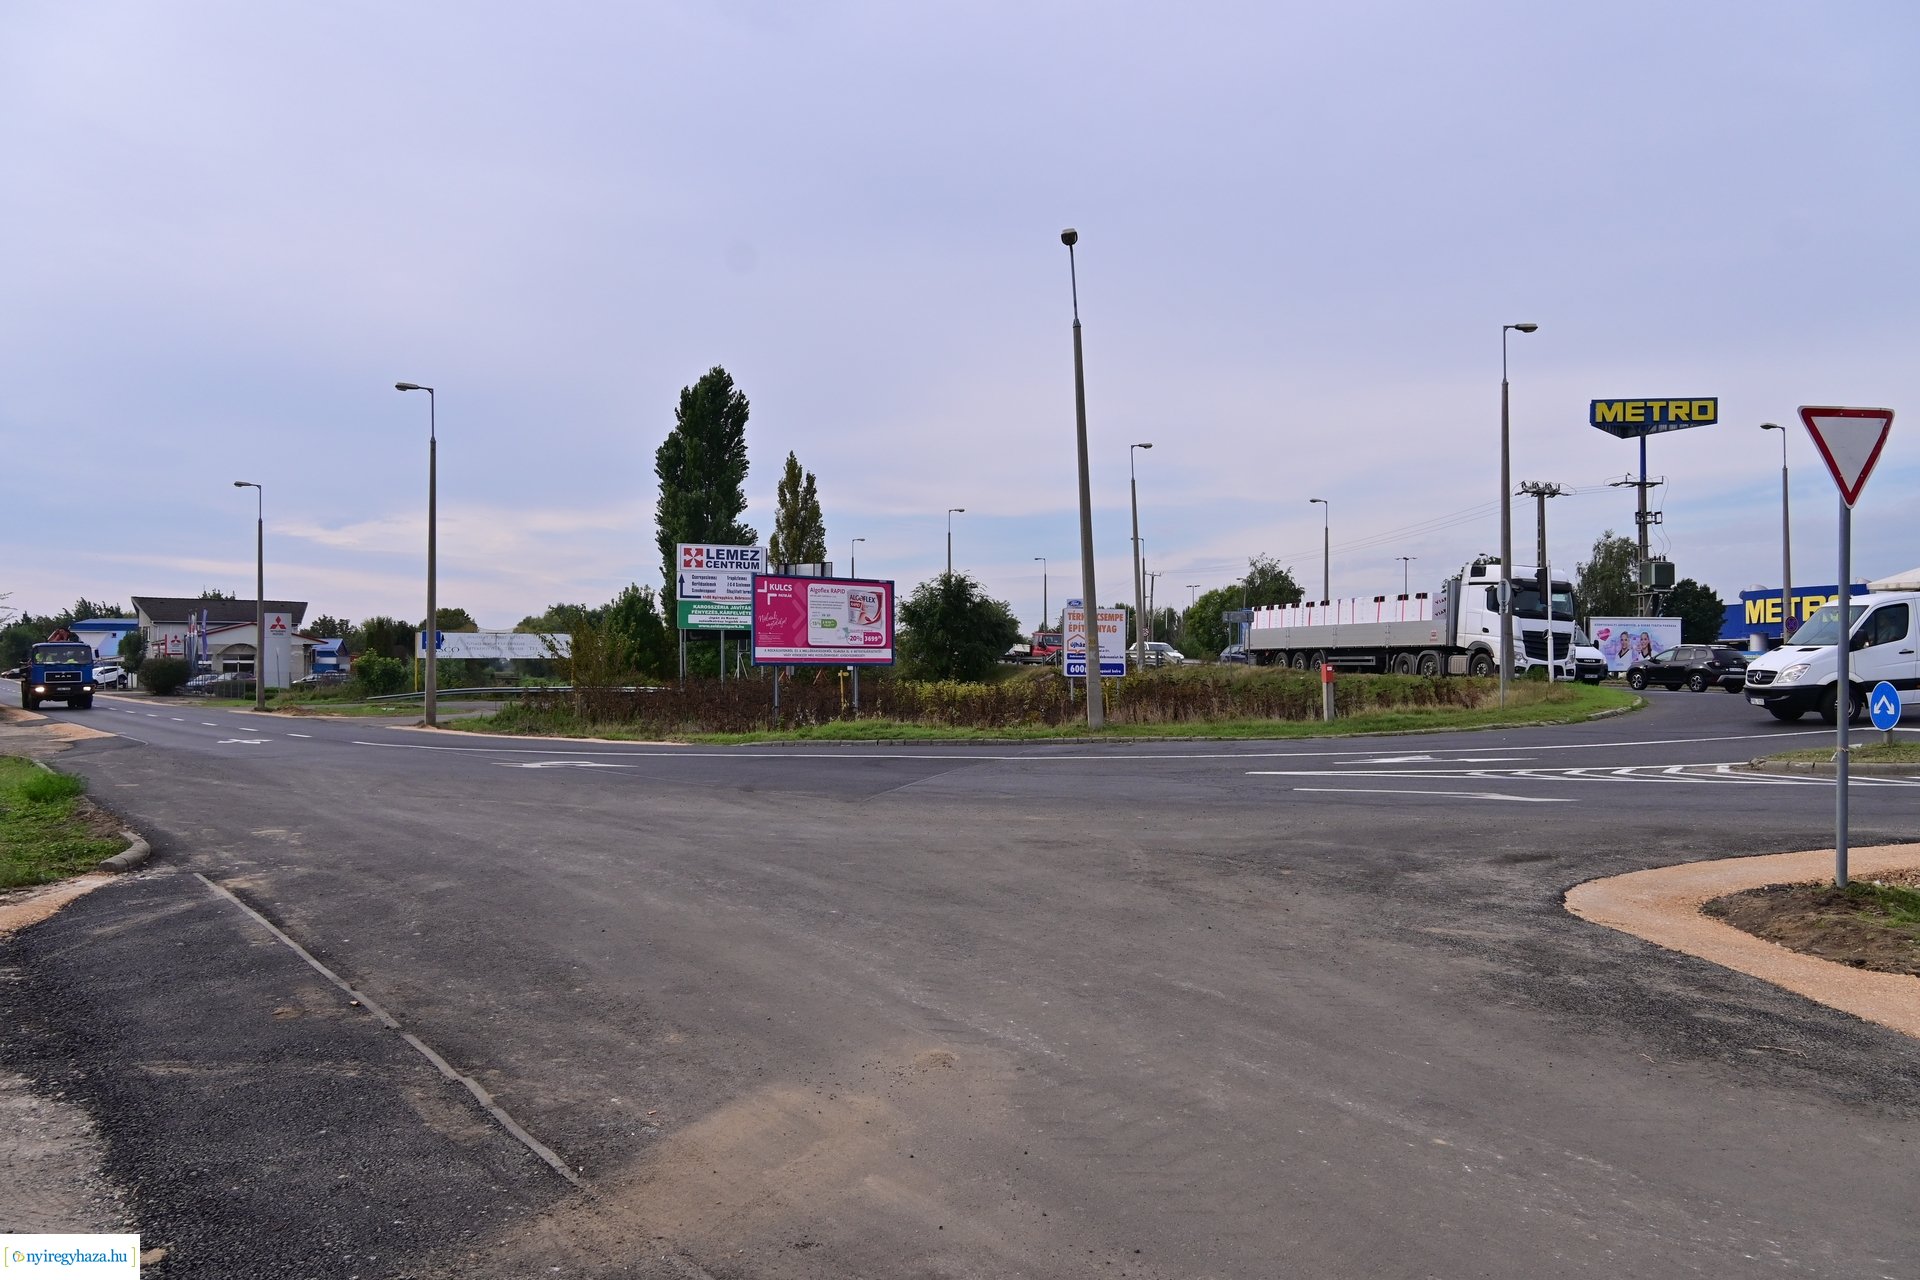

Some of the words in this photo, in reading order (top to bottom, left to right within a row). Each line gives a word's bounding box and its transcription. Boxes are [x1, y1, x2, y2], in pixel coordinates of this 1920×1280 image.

[1595, 400, 1715, 423] METRO
[706, 548, 760, 561] LEMEZ
[706, 560, 760, 570] CENTRUM
[770, 584, 792, 592] KULCS
[850, 594, 876, 604] ALGOFLEX
[1746, 595, 1840, 624] METR
[1070, 664, 1086, 673] 600
